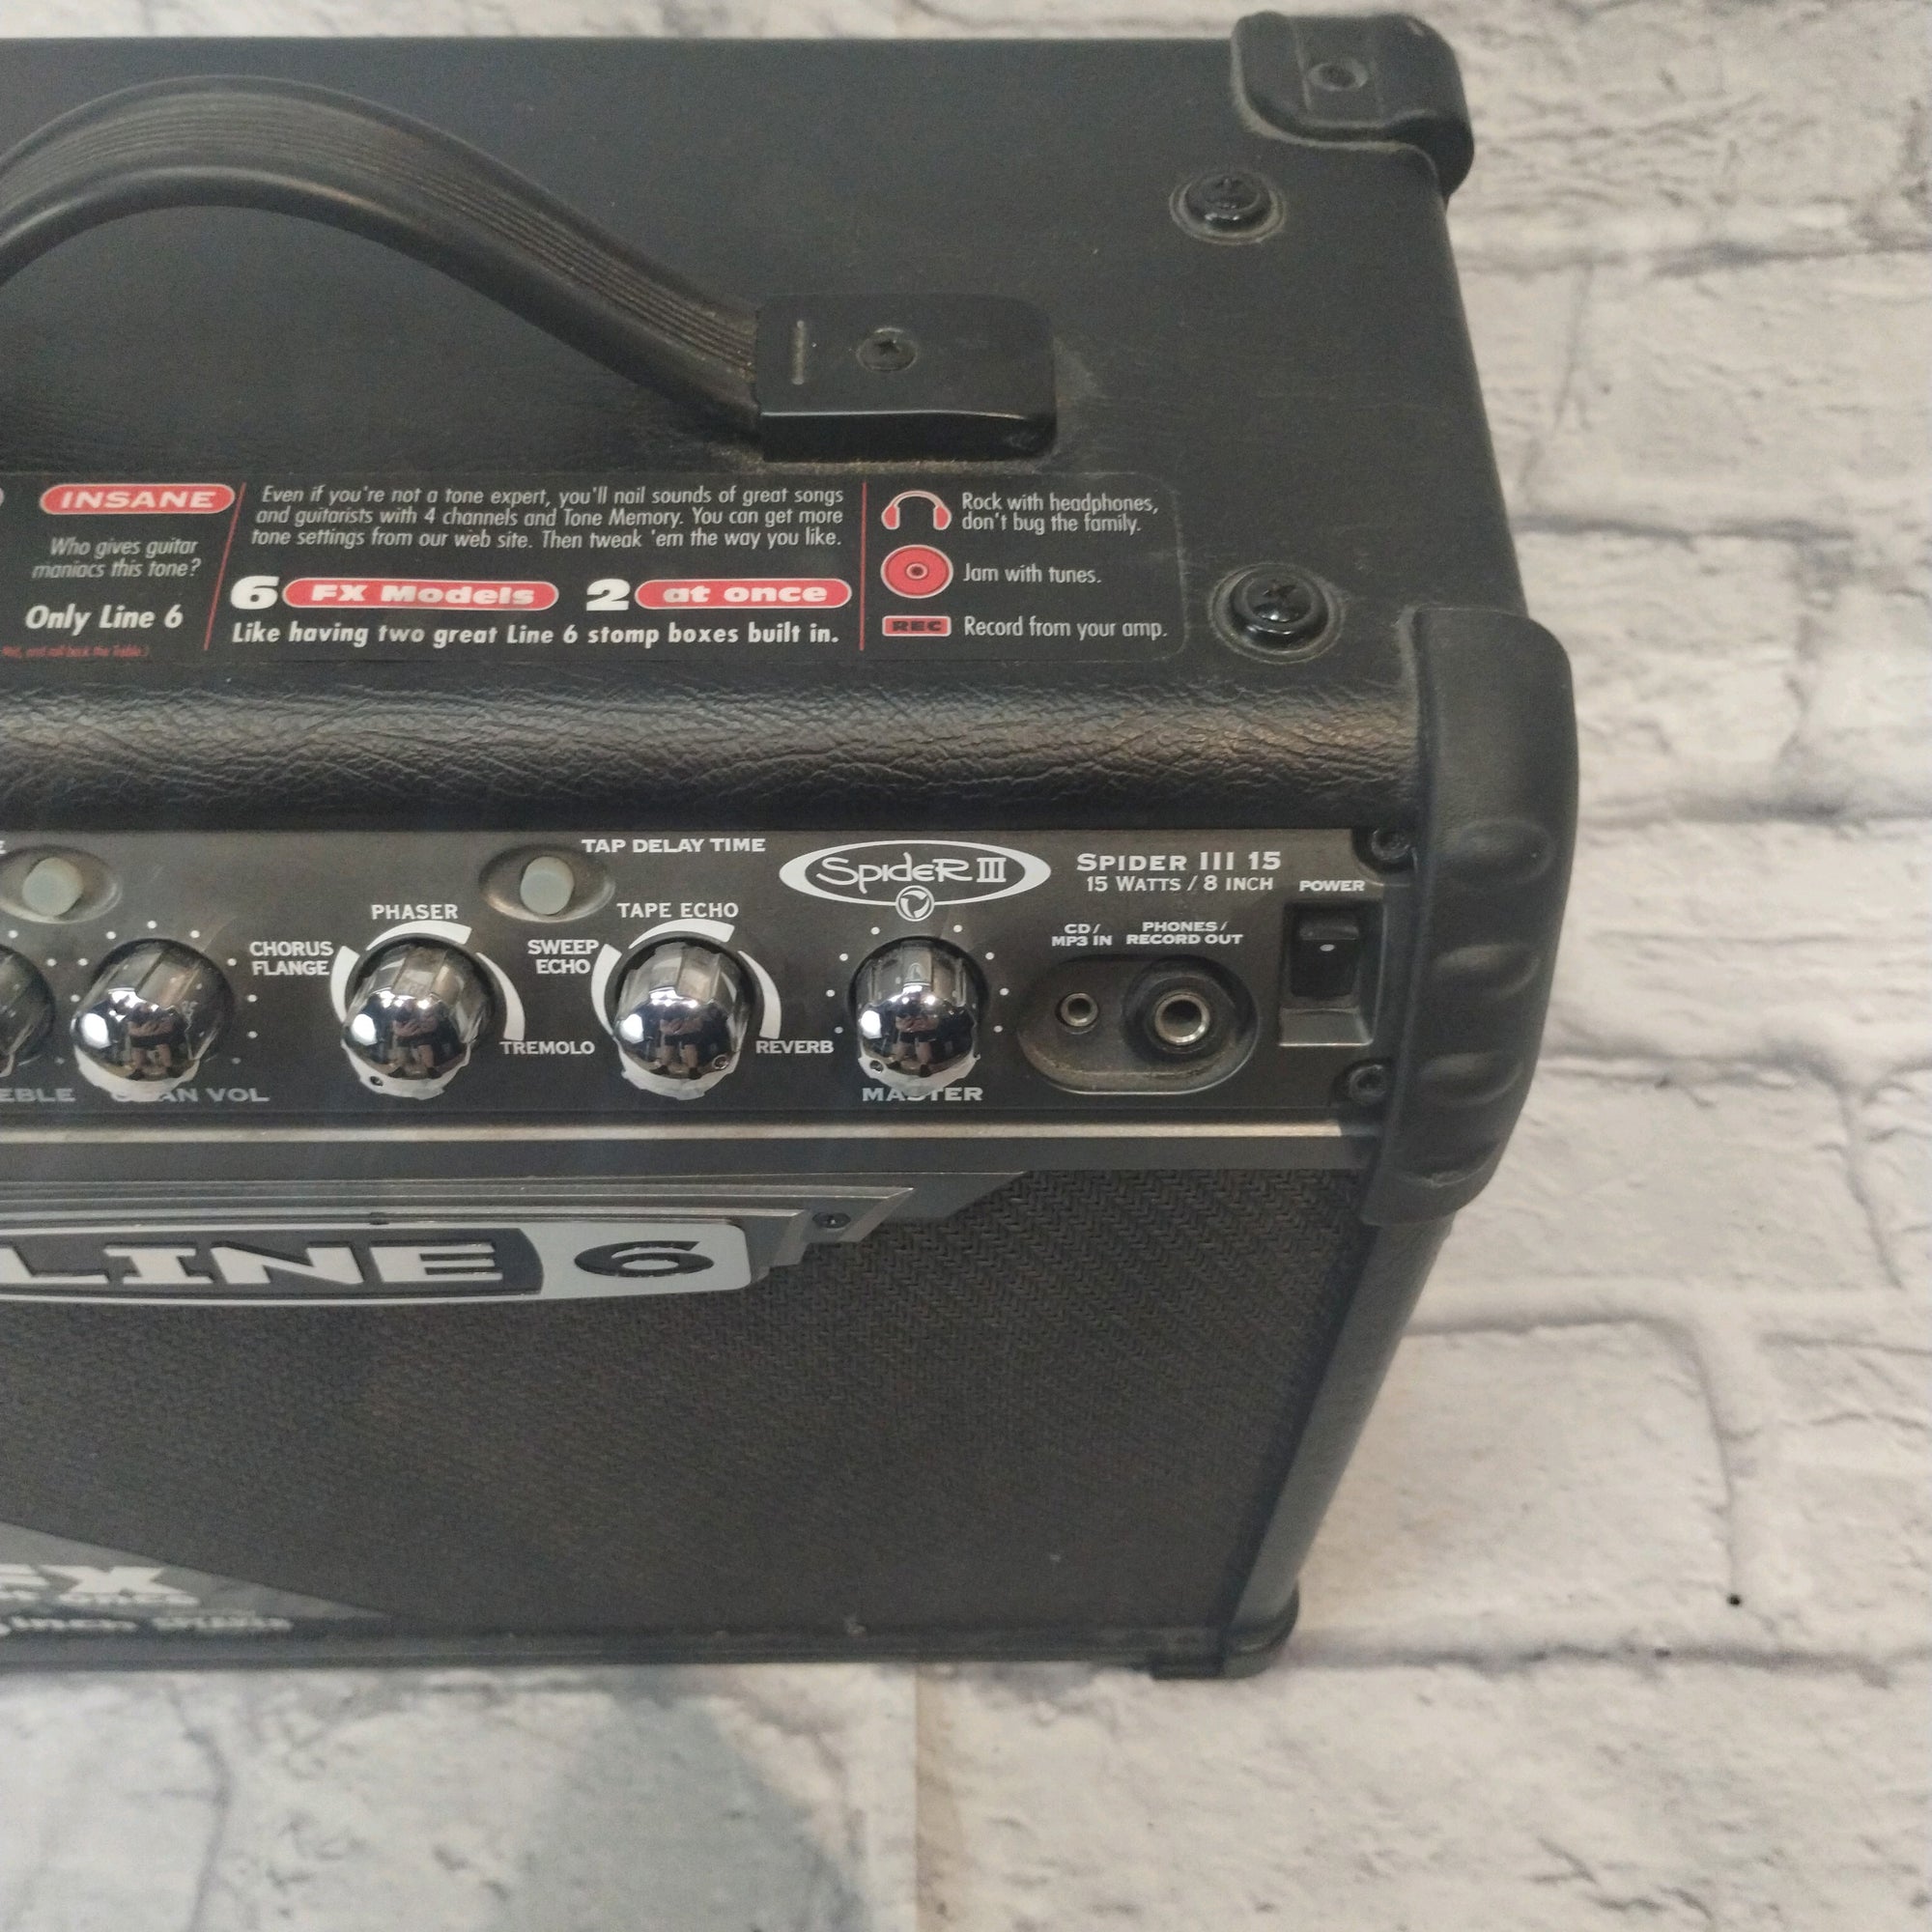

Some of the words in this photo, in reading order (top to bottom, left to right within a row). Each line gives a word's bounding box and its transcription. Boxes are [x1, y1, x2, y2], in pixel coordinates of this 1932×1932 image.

[60, 491, 214, 509] INSANE
[262, 486, 303, 502] Even
[311, 485, 324, 502] if
[328, 486, 384, 506] you're
[391, 487, 421, 503] not
[427, 491, 439, 503] a
[444, 488, 483, 503] tone
[490, 489, 551, 508] expert,
[559, 486, 607, 507] you'll
[614, 486, 645, 504] nail
[651, 486, 713, 504] sounds
[718, 486, 738, 503] of
[742, 487, 788, 506] great
[794, 490, 844, 506] songs
[961, 492, 1003, 511] Rock
[1008, 493, 1044, 511] with
[1049, 493, 1159, 514] headphones,
[256, 505, 289, 524] and
[295, 506, 373, 526] guitarists
[380, 506, 417, 524] with
[424, 507, 437, 524] 4
[442, 507, 518, 526] channels
[524, 508, 556, 526] and
[563, 508, 603, 526] Tone
[608, 508, 684, 529] Memory.
[692, 507, 724, 525] You
[728, 511, 758, 525] can
[764, 509, 793, 527] get
[799, 511, 843, 524] more
[961, 513, 1008, 530] don't
[1013, 514, 1045, 535] bug
[1051, 514, 1078, 531] the
[1084, 514, 1142, 536] family.
[50, 538, 90, 555] Who
[96, 539, 141, 558] gives
[145, 539, 198, 558] guitar
[251, 529, 292, 545] tone
[297, 529, 365, 549] settings
[371, 530, 412, 546] from
[418, 534, 447, 547] our
[454, 530, 491, 548] web
[497, 531, 533, 549] site.
[542, 531, 582, 549] Then
[589, 528, 642, 548] tweak
[650, 529, 685, 547] 'em
[690, 528, 719, 546] the
[724, 532, 760, 550] way
[767, 532, 802, 550] you
[805, 528, 842, 546] like.
[32, 560, 106, 579] maniacs
[111, 559, 146, 578] this
[149, 558, 201, 578] tone?
[963, 563, 999, 582] Jam
[1005, 565, 1042, 582] with
[1048, 566, 1102, 583] tunes.
[230, 576, 280, 611] 6
[311, 584, 368, 601] FX
[380, 584, 535, 605] Models
[585, 579, 631, 611] 2
[662, 585, 711, 603] at
[724, 586, 828, 602] once
[25, 604, 91, 636] Only
[99, 604, 155, 629] Line
[164, 605, 184, 629] 6
[892, 620, 942, 632] REC
[964, 616, 1023, 637] Record
[1029, 616, 1071, 636] from
[1076, 621, 1116, 640] your
[1122, 623, 1168, 640] amp.
[232, 622, 280, 643] Like
[288, 621, 368, 648] having
[379, 625, 424, 642] two
[434, 625, 497, 648] great
[506, 624, 554, 644] Line
[562, 625, 579, 644] 6
[587, 625, 659, 648] stomp
[668, 622, 739, 643] boxes
[748, 622, 801, 643] built
[810, 623, 840, 643] in.
[582, 838, 627, 853] TAP
[633, 838, 706, 853] DELAY
[709, 838, 766, 852] TIME
[1200, 852, 1235, 870] III
[1248, 851, 1281, 869] 15
[976, 857, 1007, 883] III
[1086, 876, 1108, 892] 15
[1203, 874, 1217, 891] 8
[1225, 876, 1274, 891] INCH
[1299, 880, 1366, 892] POWER
[371, 904, 459, 920] PHASER
[616, 902, 672, 919] TAPE
[680, 902, 739, 918] ECHO
[249, 941, 334, 956] CHORUS
[527, 939, 600, 955] SWEEP
[1051, 934, 1089, 947] MP3
[1093, 934, 1113, 947] IN
[1125, 933, 1201, 946] RECORD
[1204, 933, 1243, 945] OUT
[252, 960, 330, 976] FLANGE
[535, 958, 591, 975] ECHO
[499, 1040, 595, 1055] TREMOLO
[755, 1039, 835, 1055] REVERB
[206, 1088, 270, 1102] VOL
[574, 1240, 715, 1279] 6
